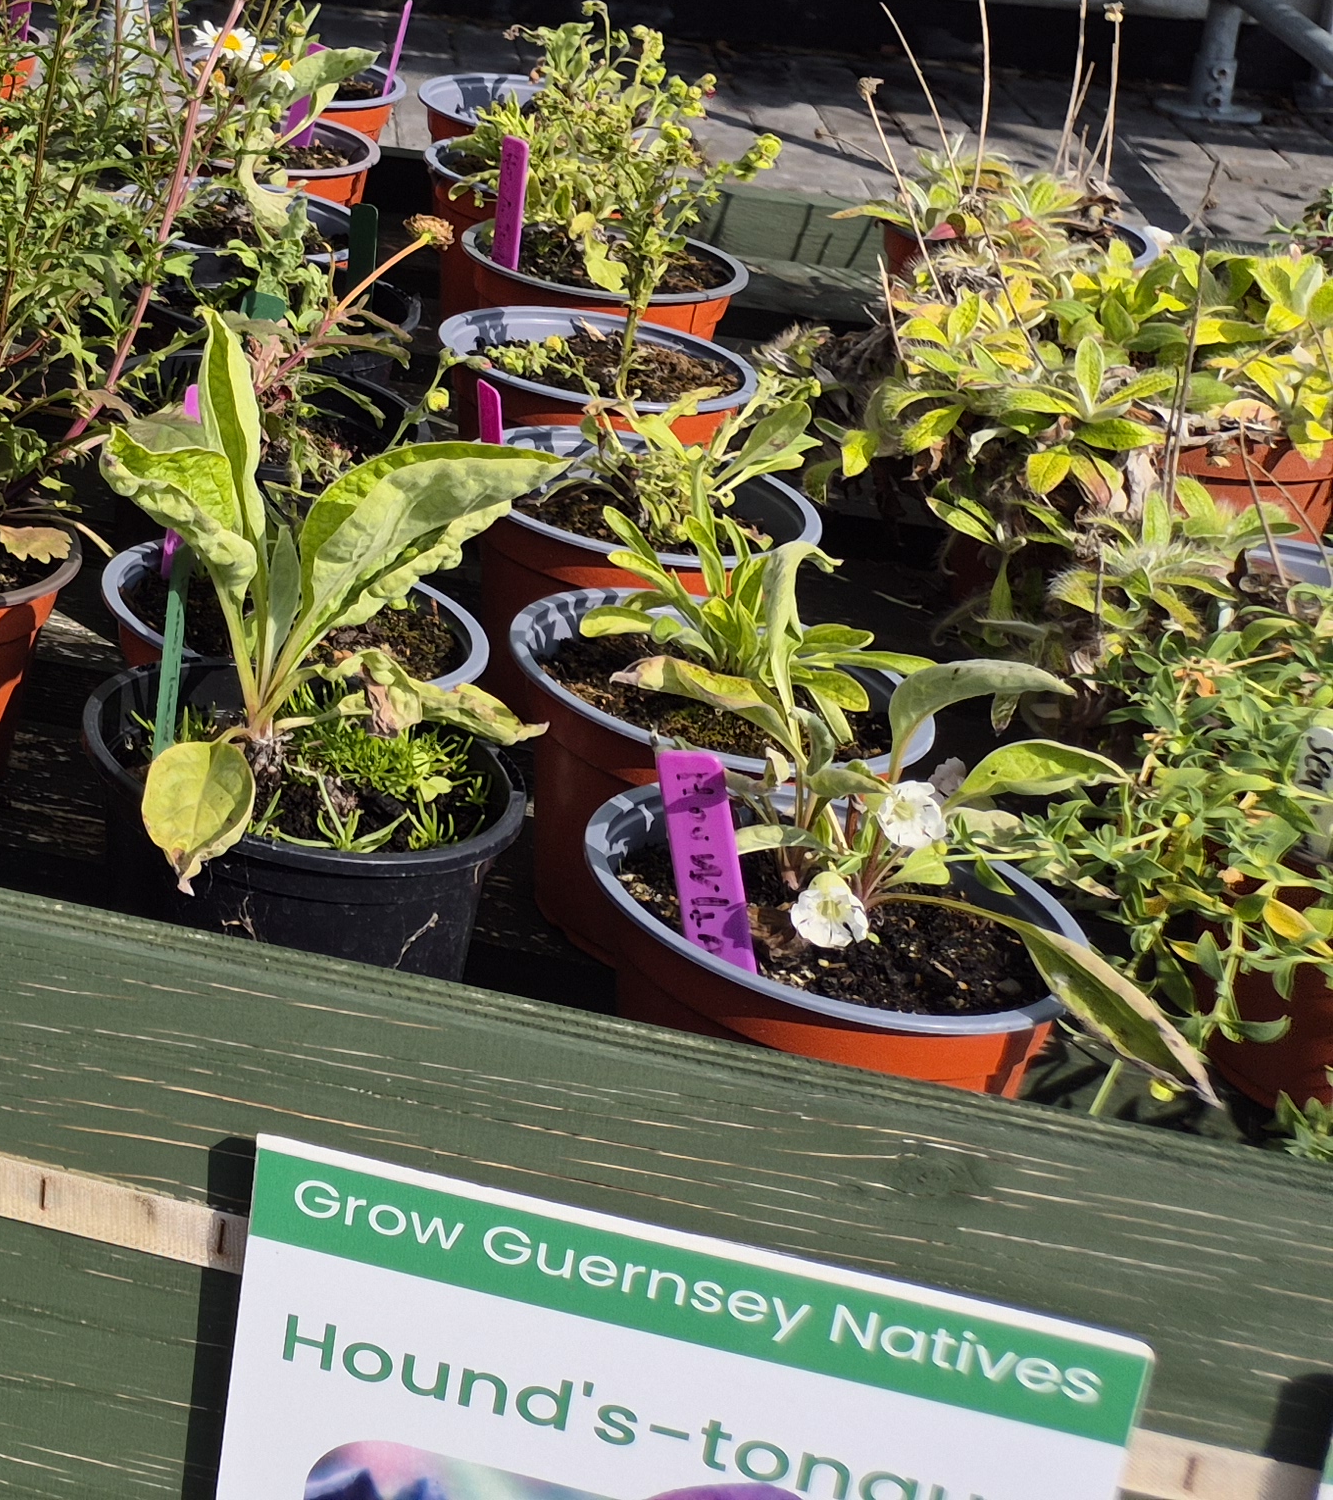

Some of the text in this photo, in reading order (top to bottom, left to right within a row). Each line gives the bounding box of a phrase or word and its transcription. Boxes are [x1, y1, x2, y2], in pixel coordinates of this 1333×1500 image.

[294, 1178, 1101, 1405] Grow Guernsey Natives
